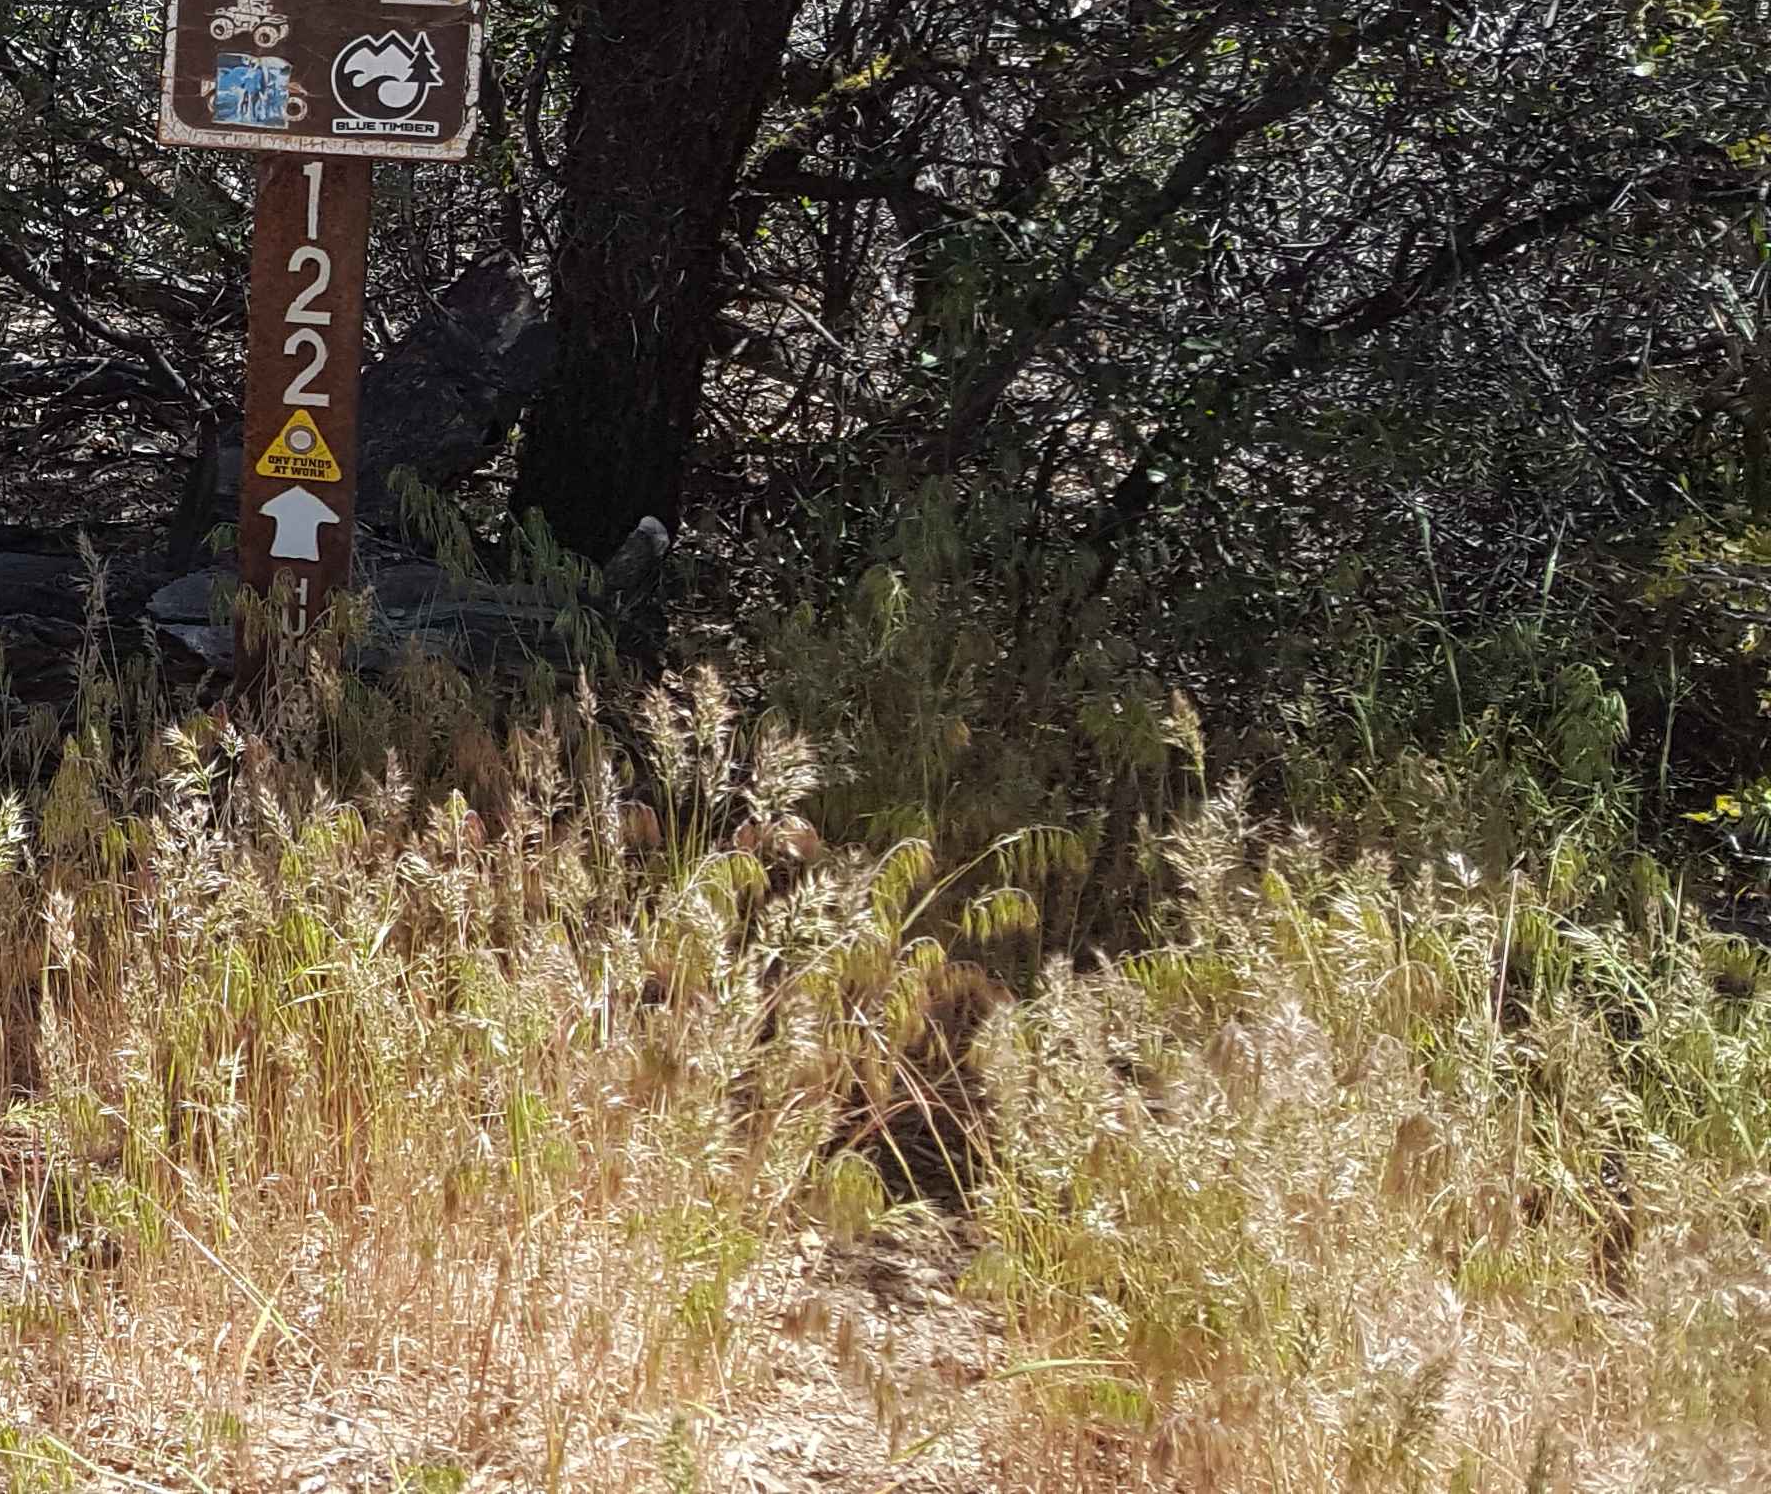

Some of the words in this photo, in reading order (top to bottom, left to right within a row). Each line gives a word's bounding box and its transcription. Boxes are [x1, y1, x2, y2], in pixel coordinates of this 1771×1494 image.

[335, 121, 376, 131] BLUE
[379, 122, 435, 133] TIMBER
[292, 457, 332, 469] FUNDS
[272, 466, 288, 474] AT
[291, 468, 327, 478] WORK
